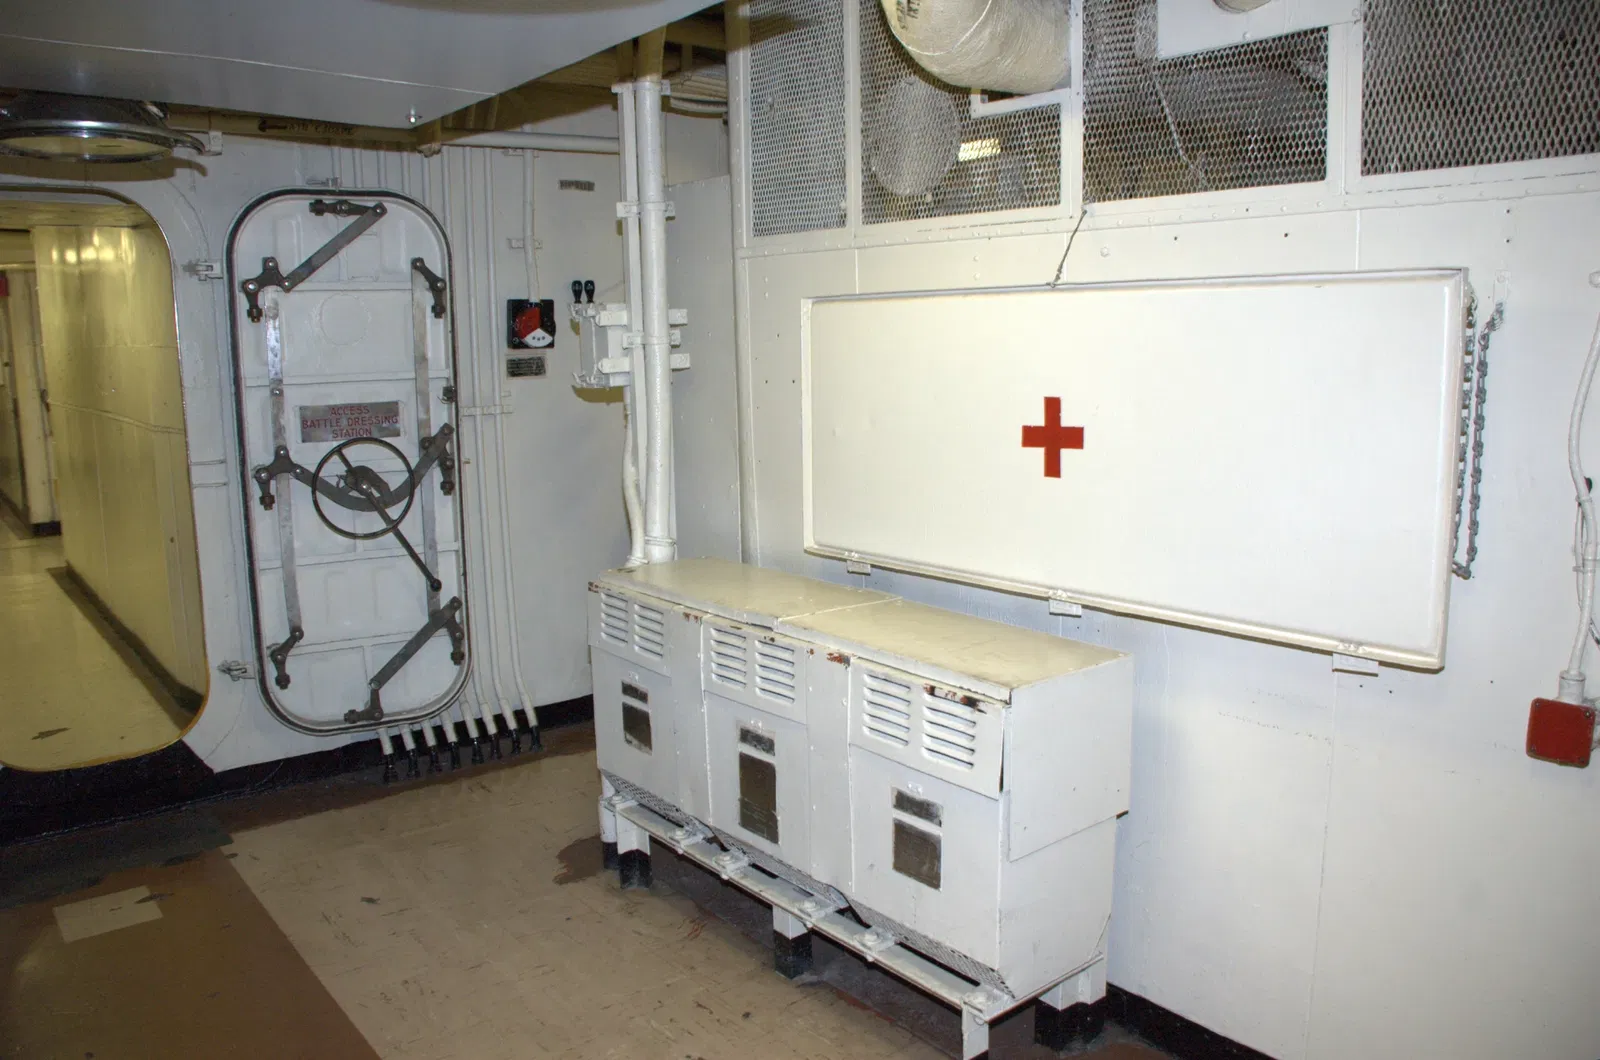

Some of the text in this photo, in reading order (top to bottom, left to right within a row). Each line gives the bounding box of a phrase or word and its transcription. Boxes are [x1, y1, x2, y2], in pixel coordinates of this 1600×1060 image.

[331, 406, 370, 416] ACCESS
[302, 415, 399, 429] BATTLE DRESSING
[332, 428, 372, 439] STATION
